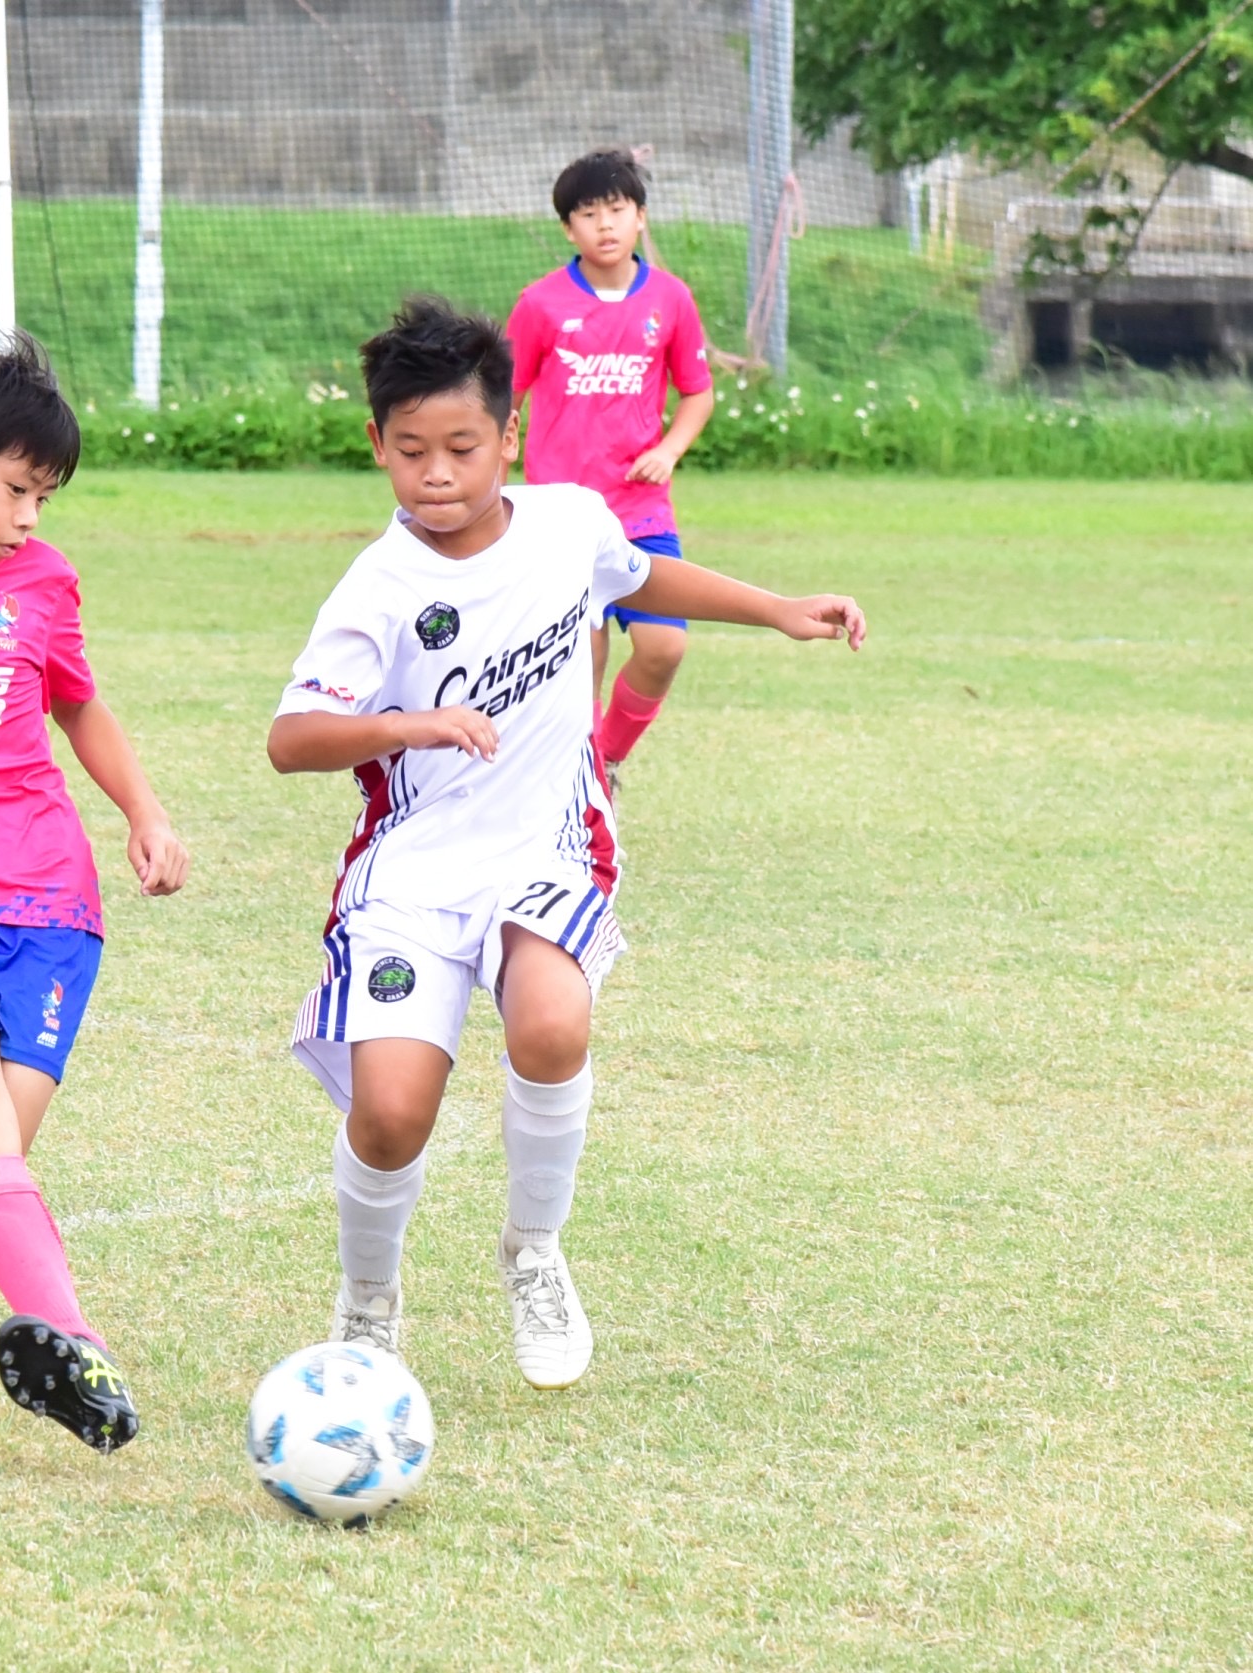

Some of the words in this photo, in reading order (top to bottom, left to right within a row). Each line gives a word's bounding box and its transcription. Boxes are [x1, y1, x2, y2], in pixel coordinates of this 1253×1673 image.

[555, 347, 654, 375] WINGS
[565, 375, 643, 395] SOCCER
[434, 586, 589, 709] Chinese
[505, 881, 571, 919] 21
